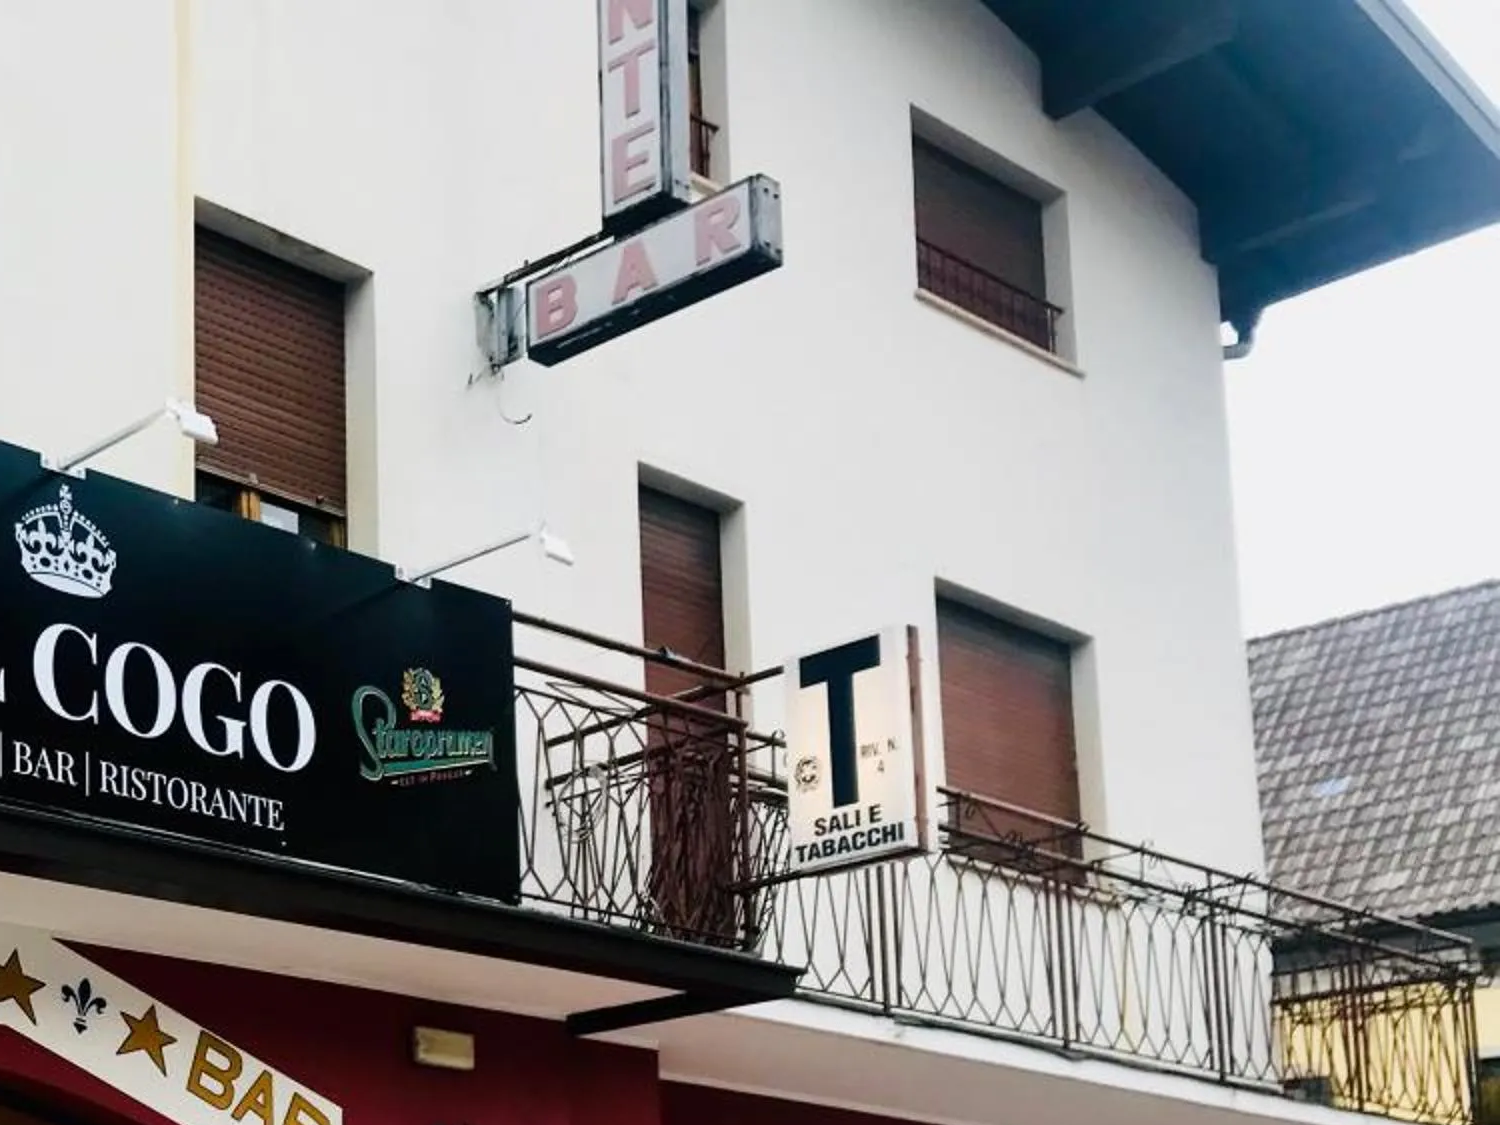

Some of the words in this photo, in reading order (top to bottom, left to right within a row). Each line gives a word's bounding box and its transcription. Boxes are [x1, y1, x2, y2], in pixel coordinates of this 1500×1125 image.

[535, 195, 742, 340] BAR
[32, 622, 317, 773] COGO
[798, 633, 881, 808] T
[12, 740, 78, 787] BAR
[99, 762, 286, 833] RISTORANTE
[795, 821, 904, 863] TABACCHI
[814, 808, 861, 837] SALI
[869, 803, 883, 824] E
